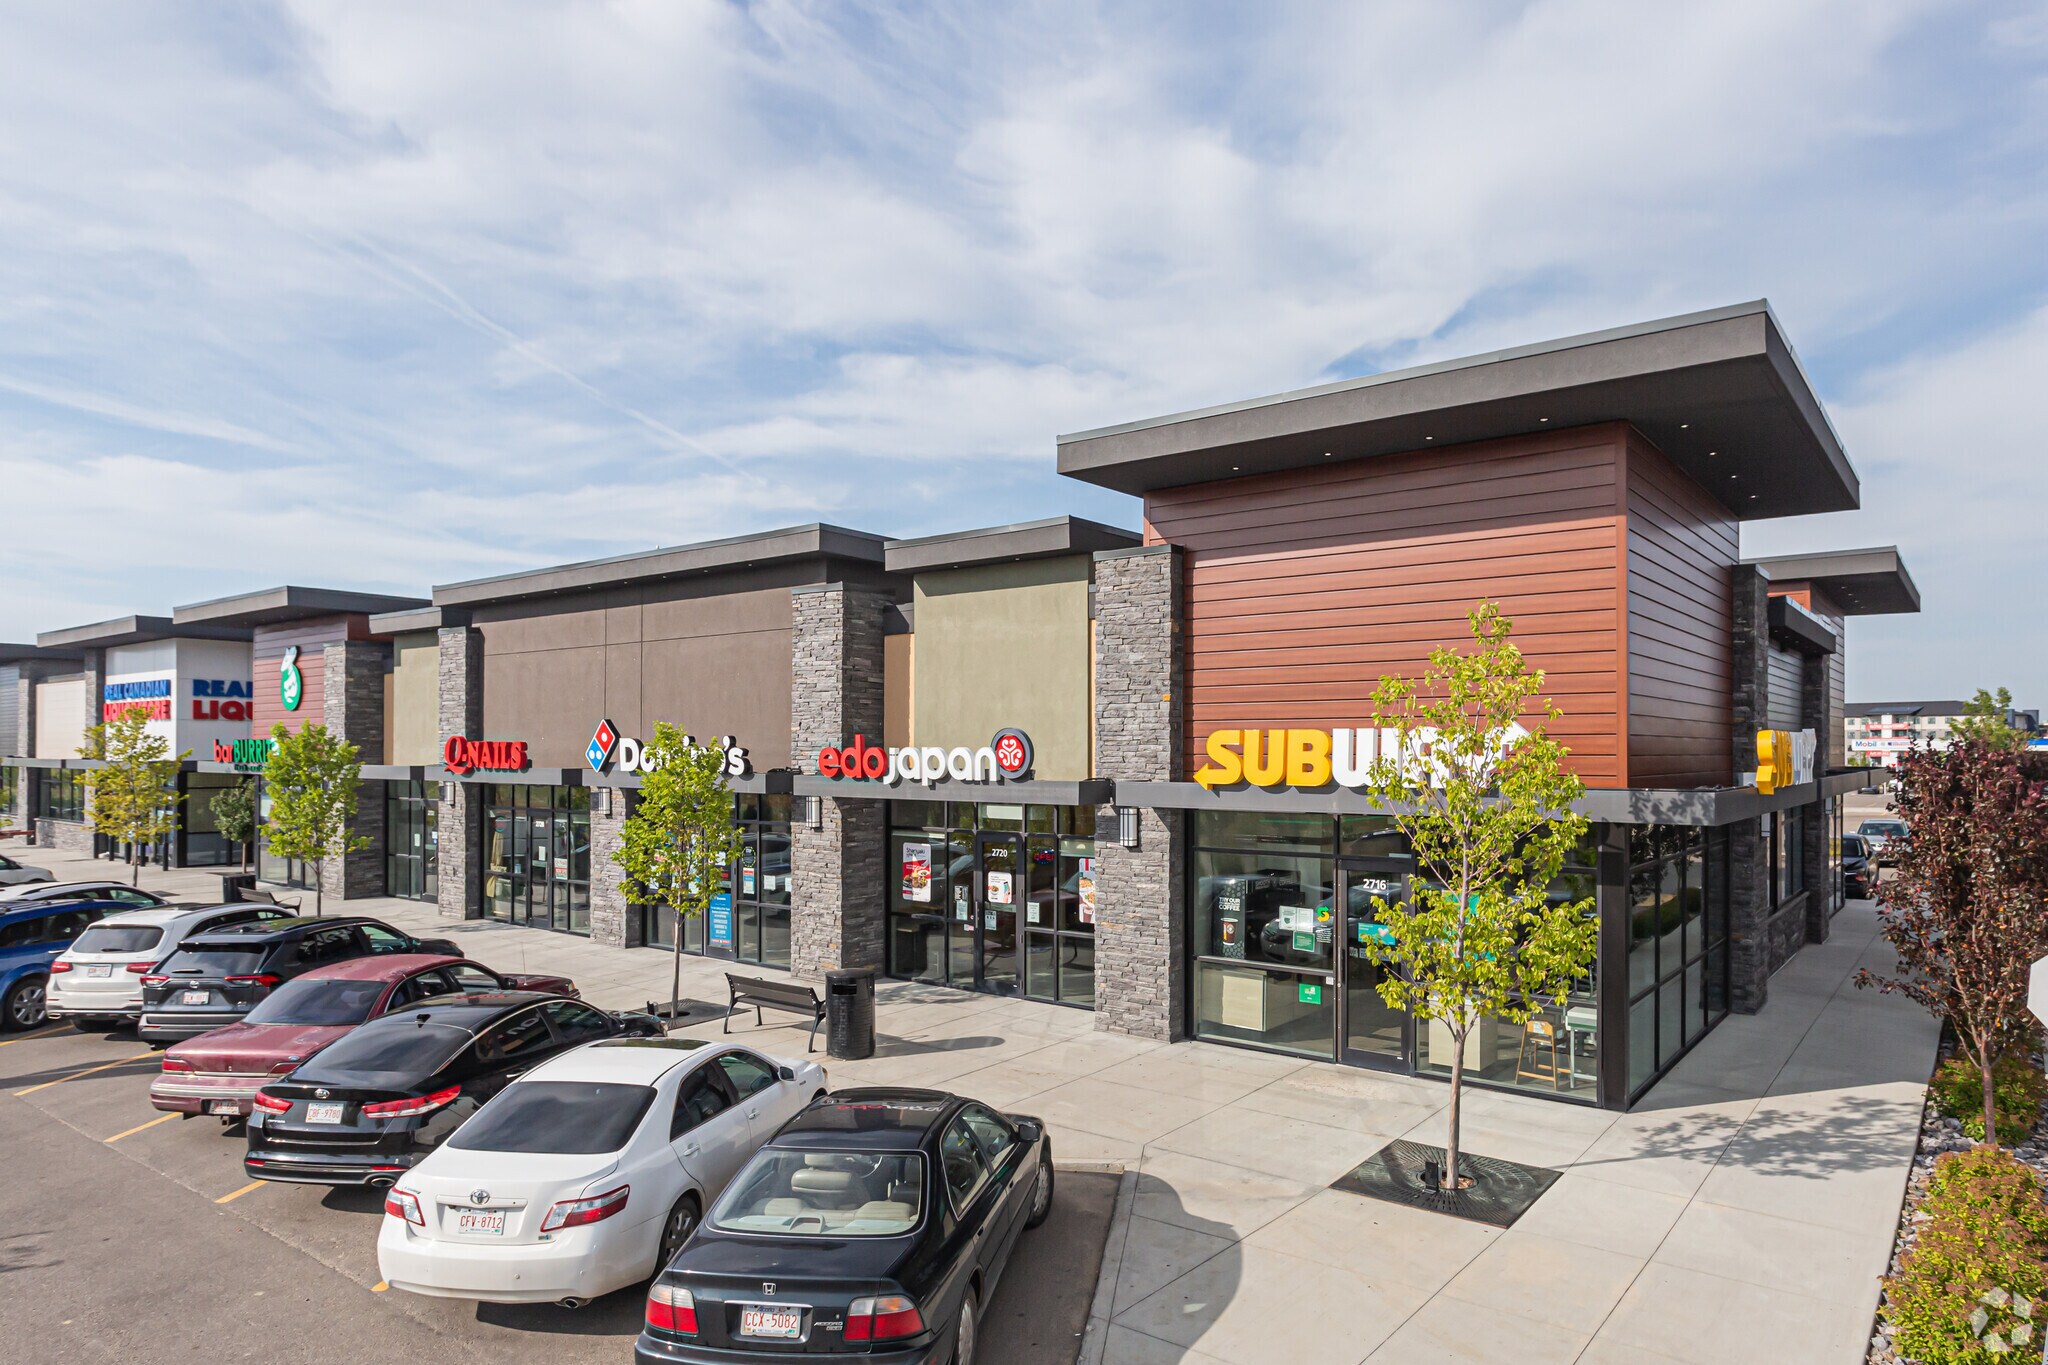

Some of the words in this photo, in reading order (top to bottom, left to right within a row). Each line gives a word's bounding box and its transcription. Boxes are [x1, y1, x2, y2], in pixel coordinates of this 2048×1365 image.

[104, 684, 123, 700] REAL
[123, 680, 167, 699] CANADIAN
[193, 700, 253, 721] LIQ
[991, 848, 1008, 857] 2720
[1363, 878, 1387, 890] 2716
[460, 1215, 502, 1229] CFV-8712
[745, 1312, 798, 1329] CCX-5082
